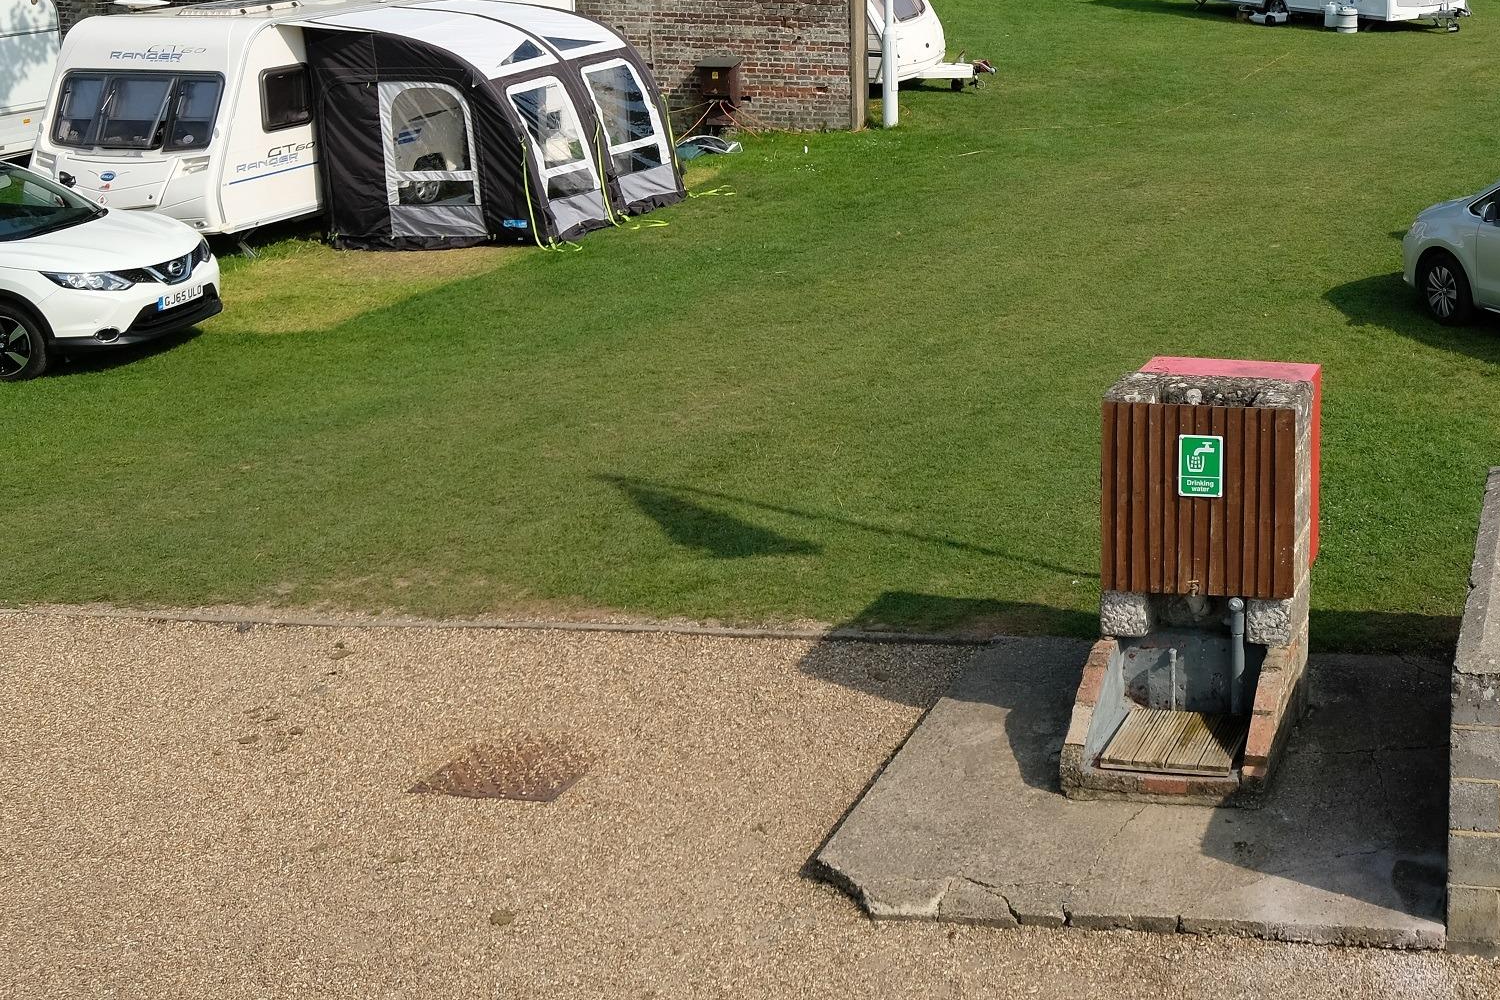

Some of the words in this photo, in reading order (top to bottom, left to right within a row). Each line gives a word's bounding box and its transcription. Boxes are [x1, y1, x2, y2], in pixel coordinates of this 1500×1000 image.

[110, 51, 183, 60] RANGER
[236, 152, 298, 173] RANGER
[164, 290, 187, 307] GJ65
[187, 284, 202, 299] ULO
[1186, 479, 1214, 488] Drinking
